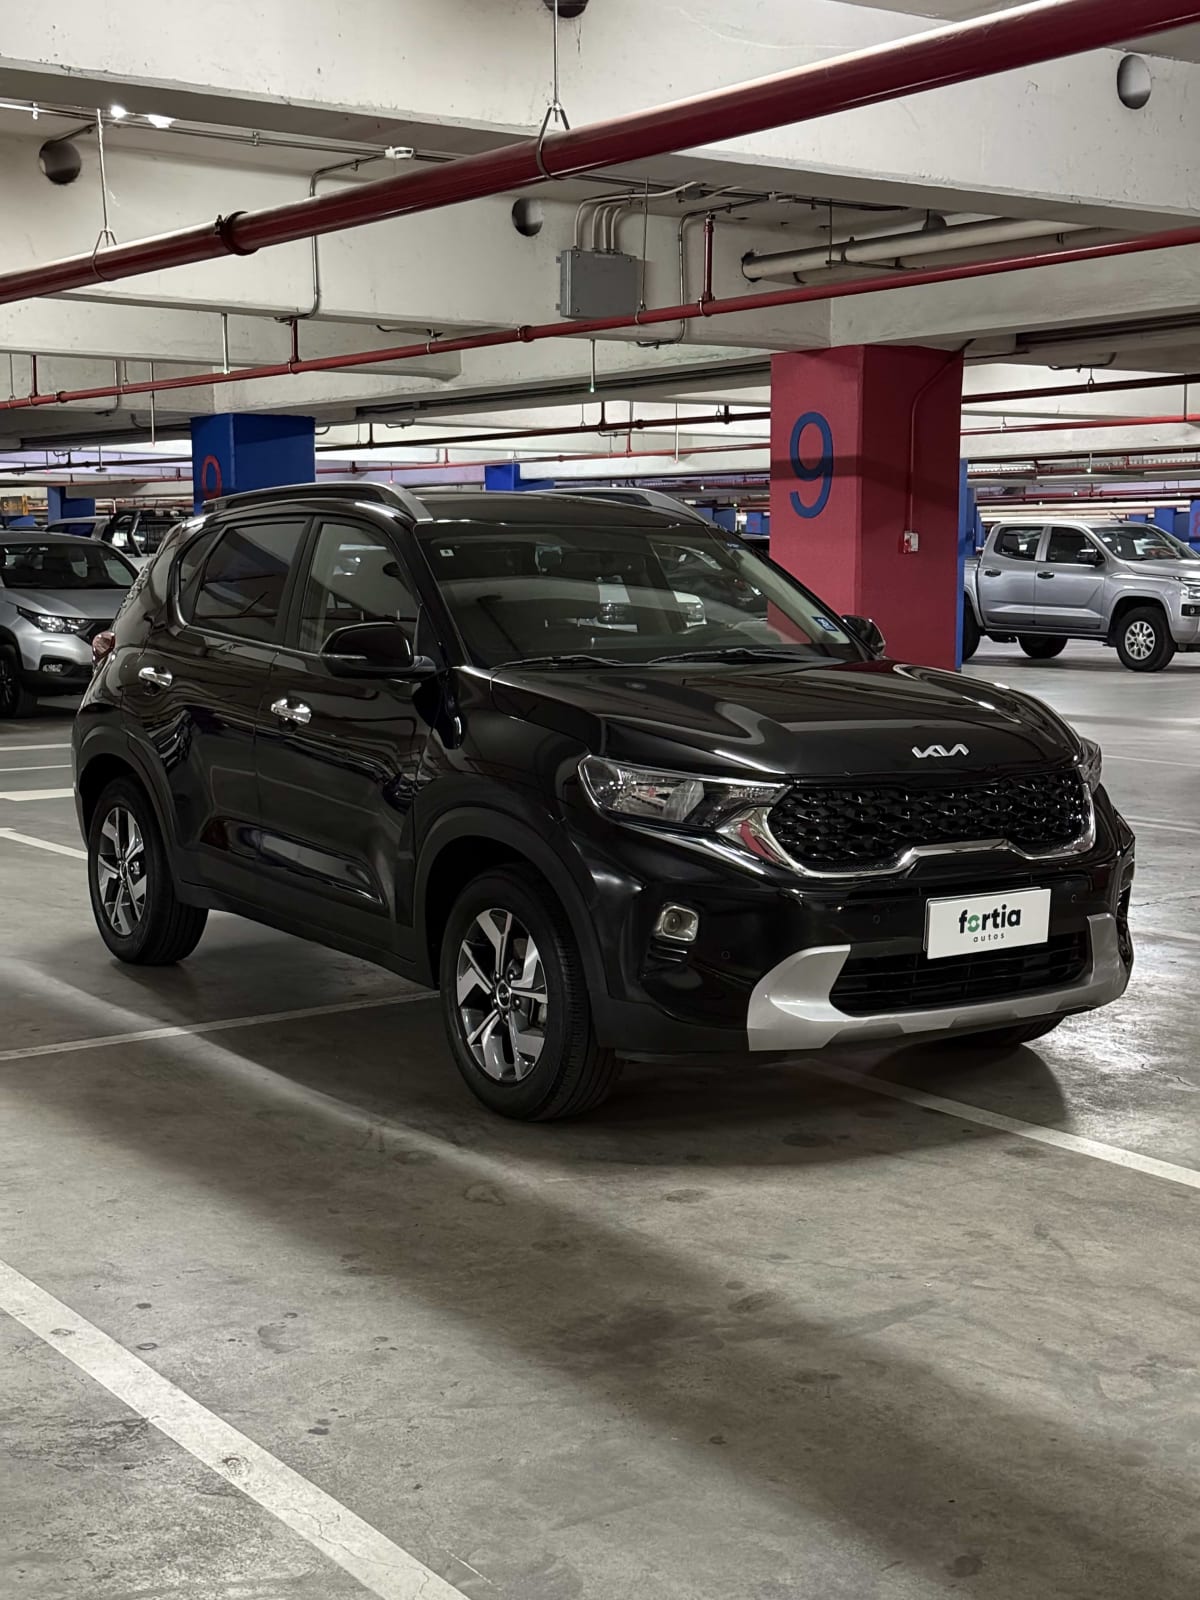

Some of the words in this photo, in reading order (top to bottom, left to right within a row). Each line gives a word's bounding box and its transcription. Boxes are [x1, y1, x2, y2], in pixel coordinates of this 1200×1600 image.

[789, 411, 834, 519] 9
[911, 743, 970, 759] KIA
[958, 903, 1022, 934] fortia
[973, 932, 1005, 943] autos
